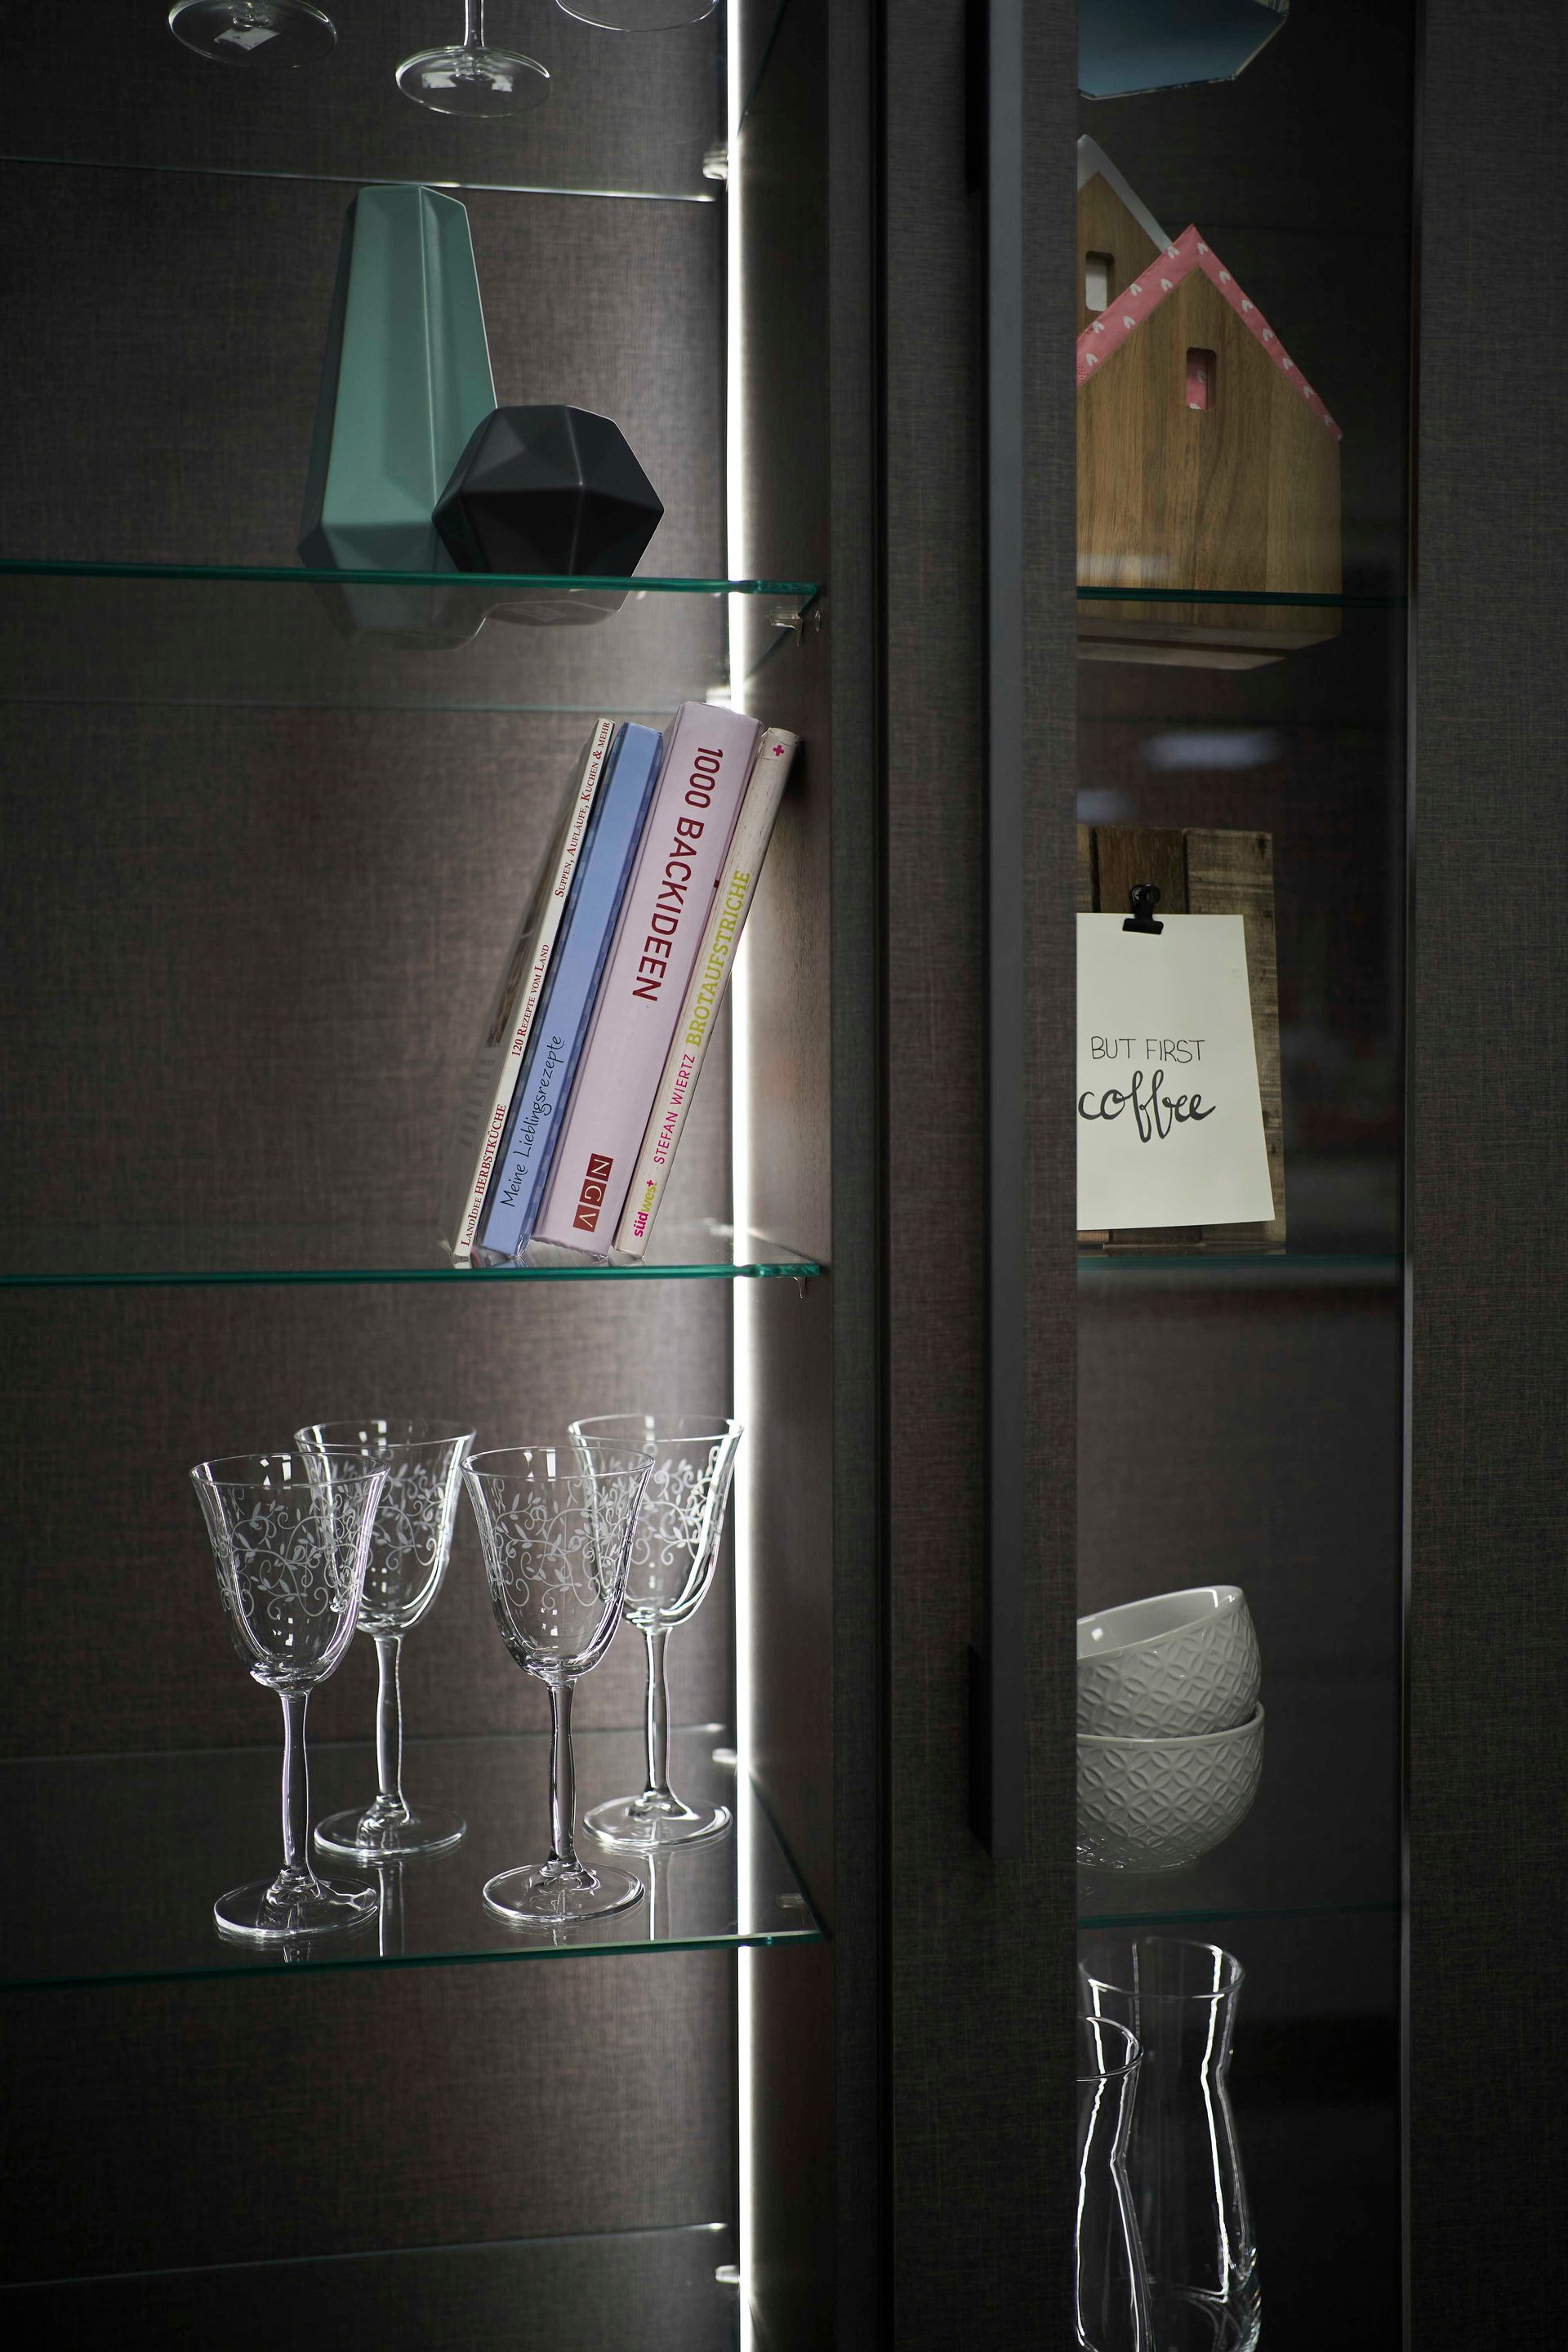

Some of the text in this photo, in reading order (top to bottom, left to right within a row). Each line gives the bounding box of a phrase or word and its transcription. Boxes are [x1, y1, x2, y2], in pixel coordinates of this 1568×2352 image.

[592, 750, 602, 760] &
[598, 721, 611, 748] MEHR
[632, 747, 724, 1002] 1000 BACKIDEEN
[511, 944, 550, 1057] 120 REZEPTE VOM LAND
[686, 870, 751, 1047] BROTAUFSTRICHE
[1090, 1036, 1205, 1063] BUT FIRST
[474, 1103, 506, 1196] HERBSTKÜCHE
[500, 1036, 564, 1208] Meine Lieblingsrezepte
[653, 1054, 696, 1165] STEFAN WIERTZ
[1078, 1069, 1216, 1143] coffee
[577, 1156, 612, 1230] NGV
